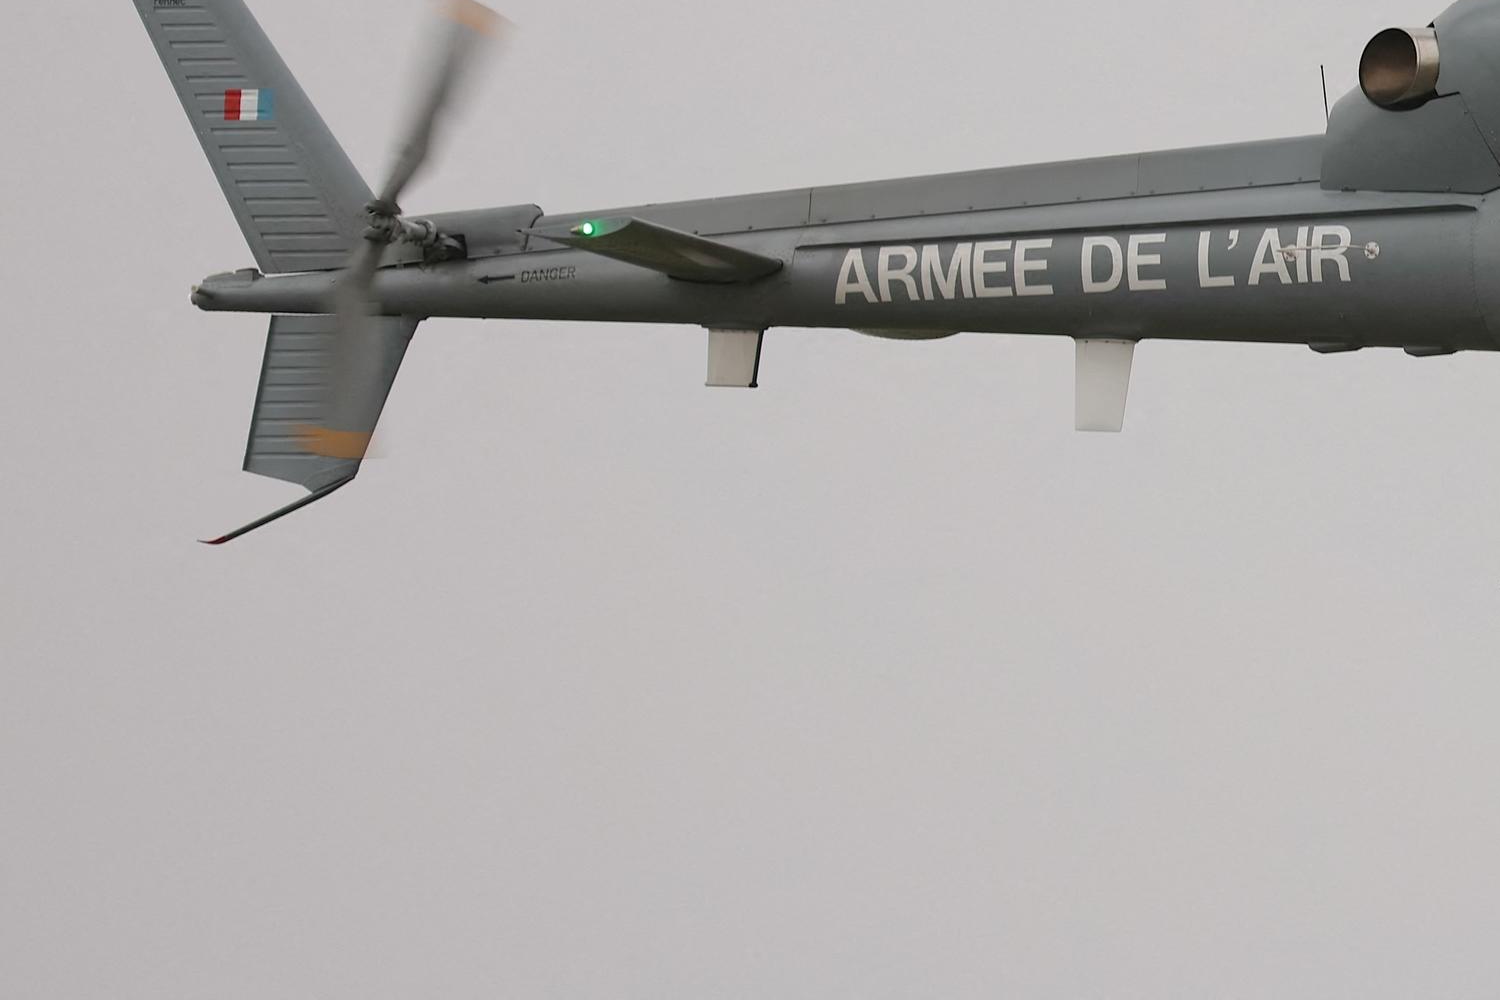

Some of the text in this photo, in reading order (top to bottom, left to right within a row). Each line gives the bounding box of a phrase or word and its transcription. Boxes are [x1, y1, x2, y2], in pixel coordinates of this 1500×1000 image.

[520, 265, 576, 284] DANGER
[834, 225, 1351, 305] ARMEE DE L'AIR
